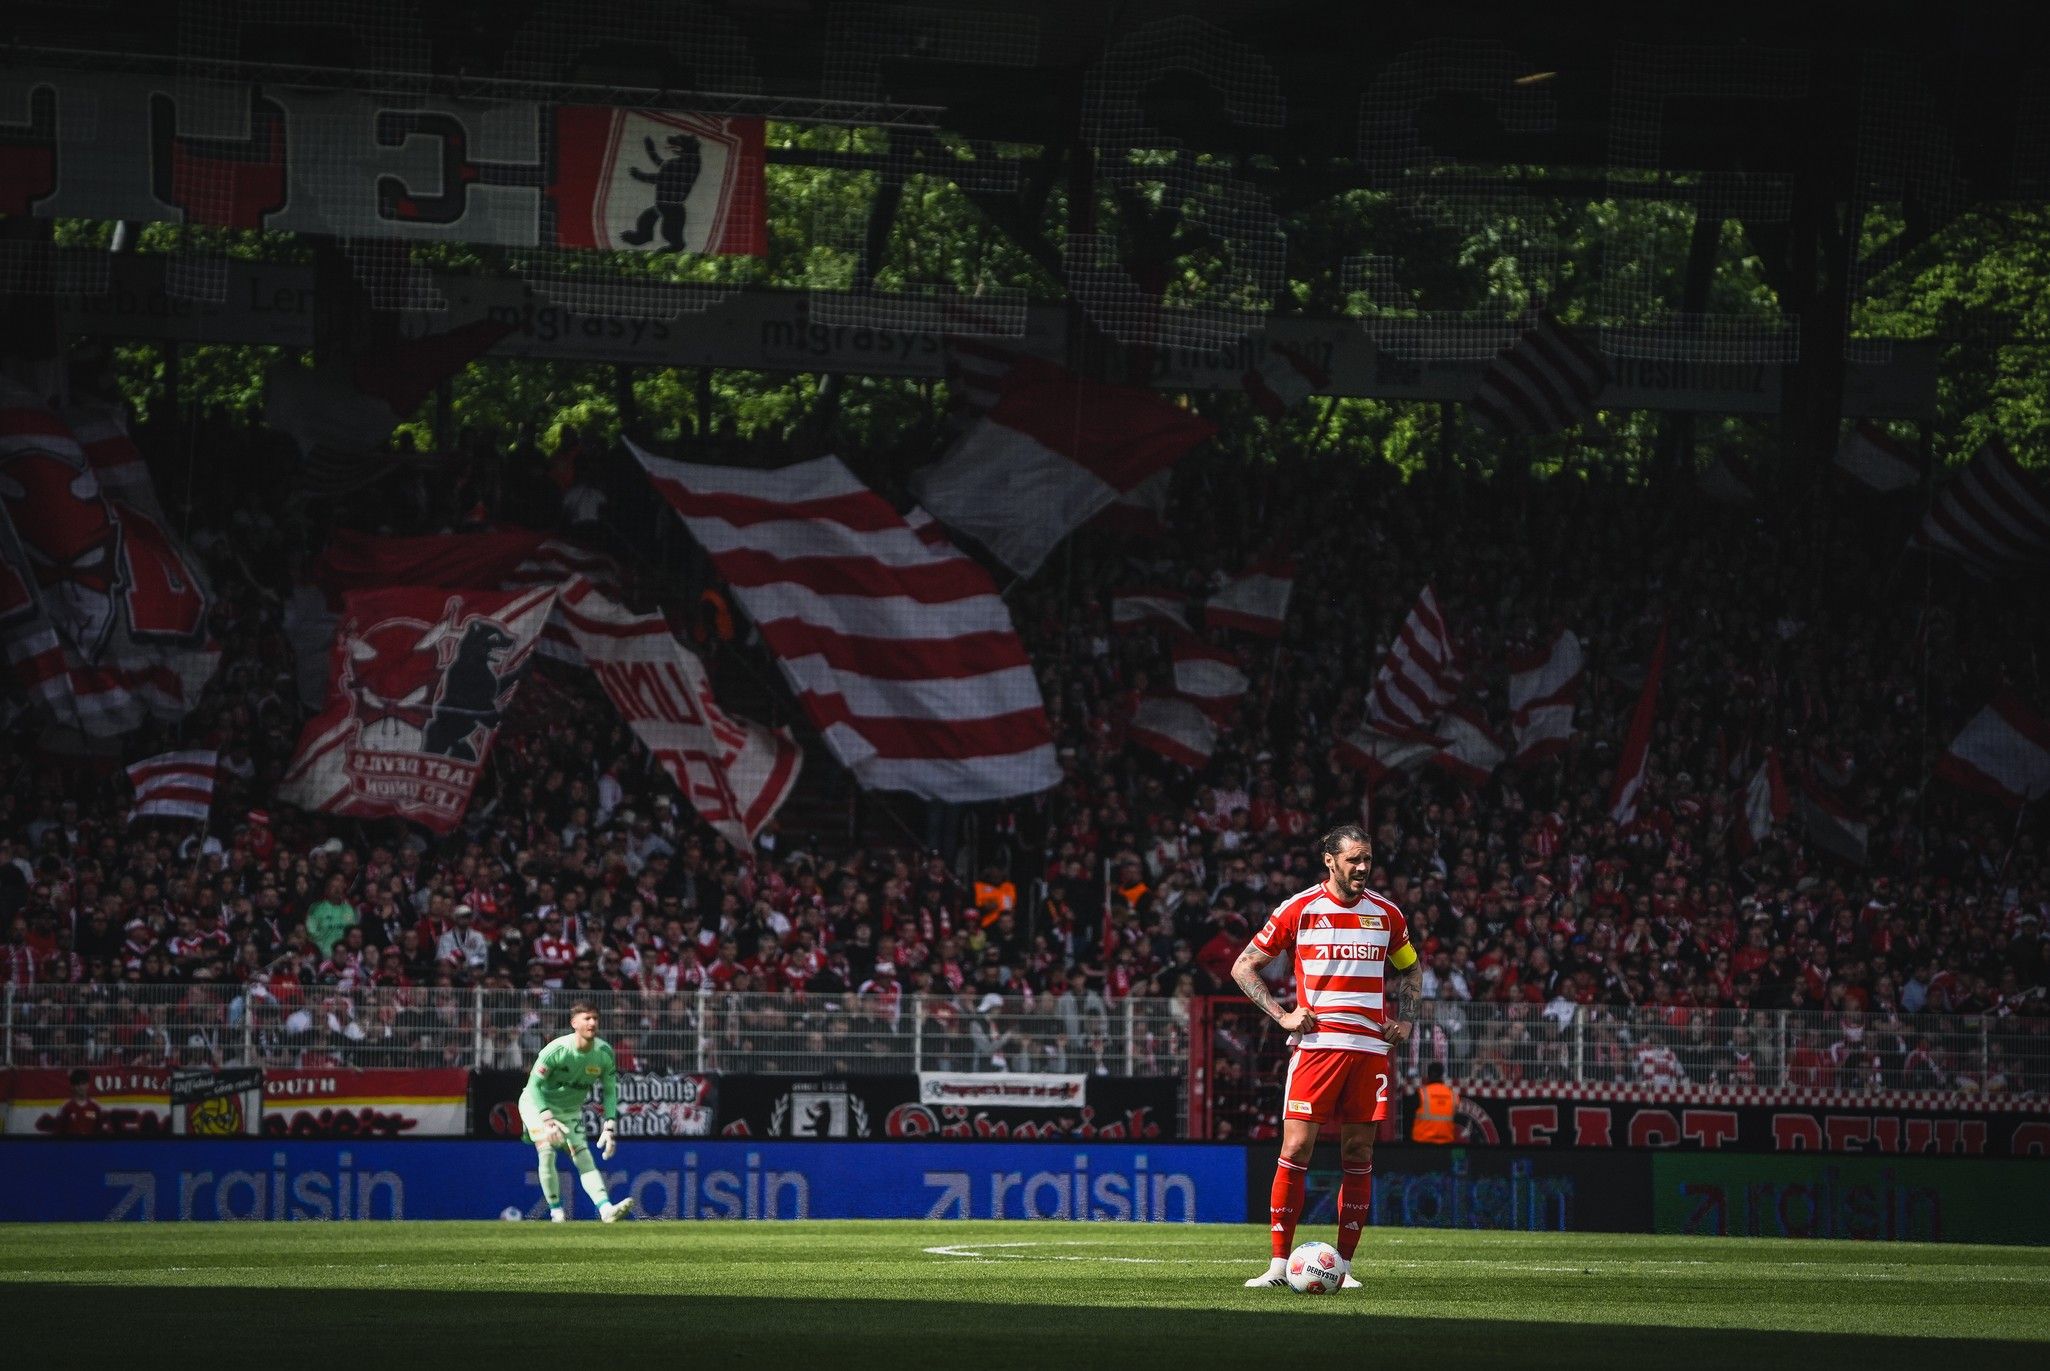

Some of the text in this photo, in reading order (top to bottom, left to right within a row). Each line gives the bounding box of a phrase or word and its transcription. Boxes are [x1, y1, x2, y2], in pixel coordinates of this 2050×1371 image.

[486, 297, 671, 344] migrasys
[762, 304, 938, 358] migrasys
[1333, 942, 1379, 960] raisin
[179, 1151, 403, 1221] raisin
[990, 1153, 1197, 1223] raisin
[1745, 1166, 1942, 1241] raisin
[1306, 1265, 1339, 1282] DERBYSTAR
